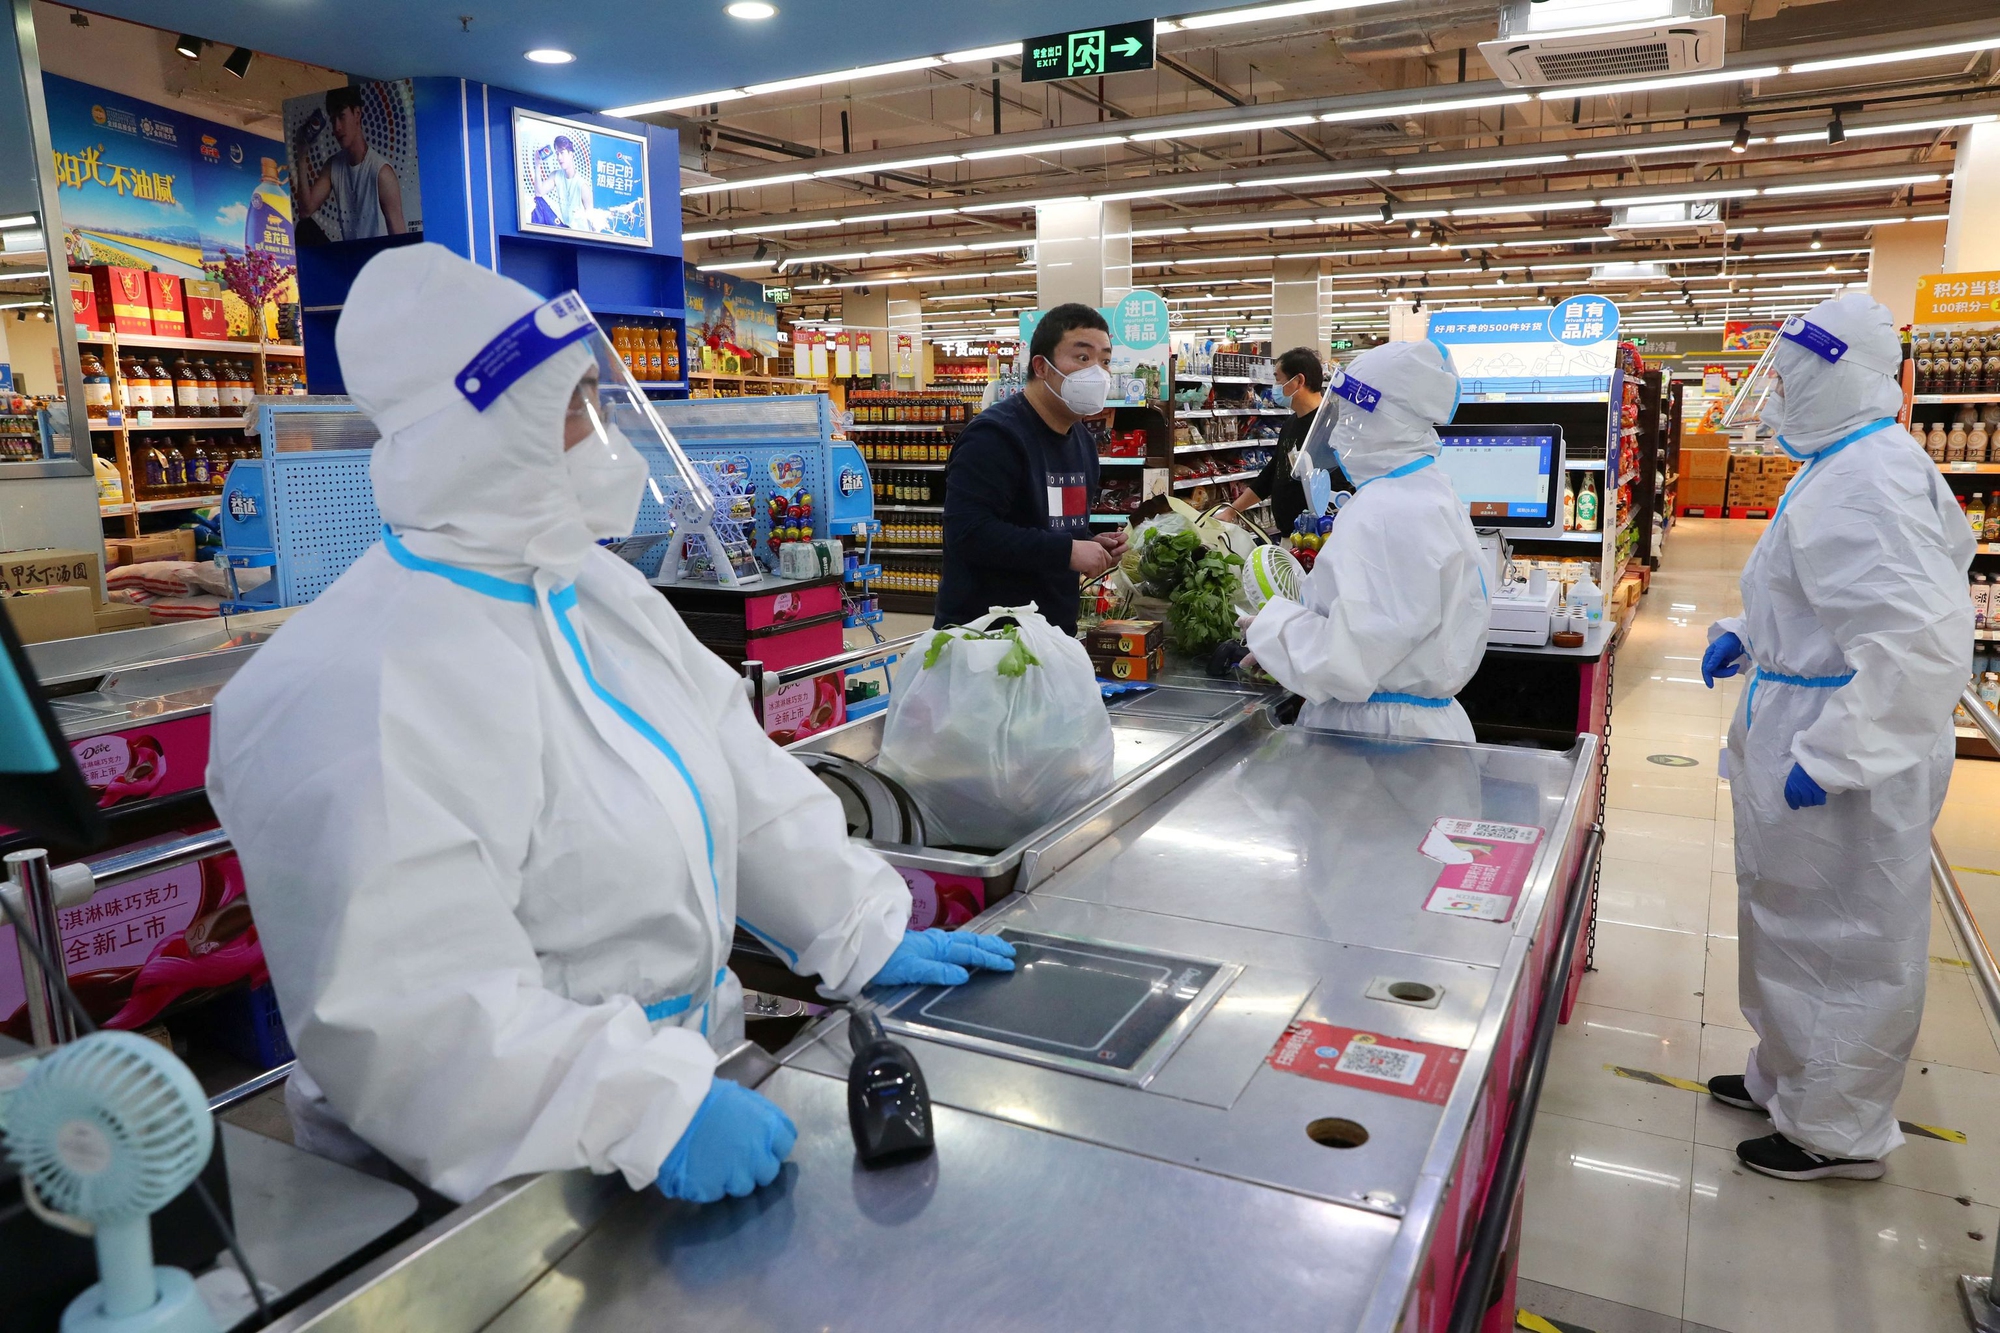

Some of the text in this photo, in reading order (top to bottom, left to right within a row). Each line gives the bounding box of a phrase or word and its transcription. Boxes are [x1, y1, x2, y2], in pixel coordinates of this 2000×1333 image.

[1033, 45, 1062, 59] 安全出口
[1036, 58, 1058, 68] EXIT
[264, 231, 291, 247] 金龙鱼
[1125, 299, 1156, 317] 进口
[1565, 302, 1606, 318] 自有
[1125, 324, 1157, 341] 精品
[1434, 322, 1543, 334] 好用不贵的500件好货
[1561, 323, 1604, 339] 品牌
[942, 342, 968, 357] 干货
[969, 347, 983, 356] DRY
[842, 475, 863, 491] 益达
[1047, 475, 1084, 485] TOMMY
[231, 496, 257, 515] 益达
[1051, 518, 1085, 528] JEANS
[11, 562, 88, 586] 甲天下汤圆
[774, 707, 804, 726] 全新上市
[79, 745, 111, 760] Dove
[58, 882, 178, 931] 淇淋味巧克力
[66, 915, 166, 965] 全新上市
